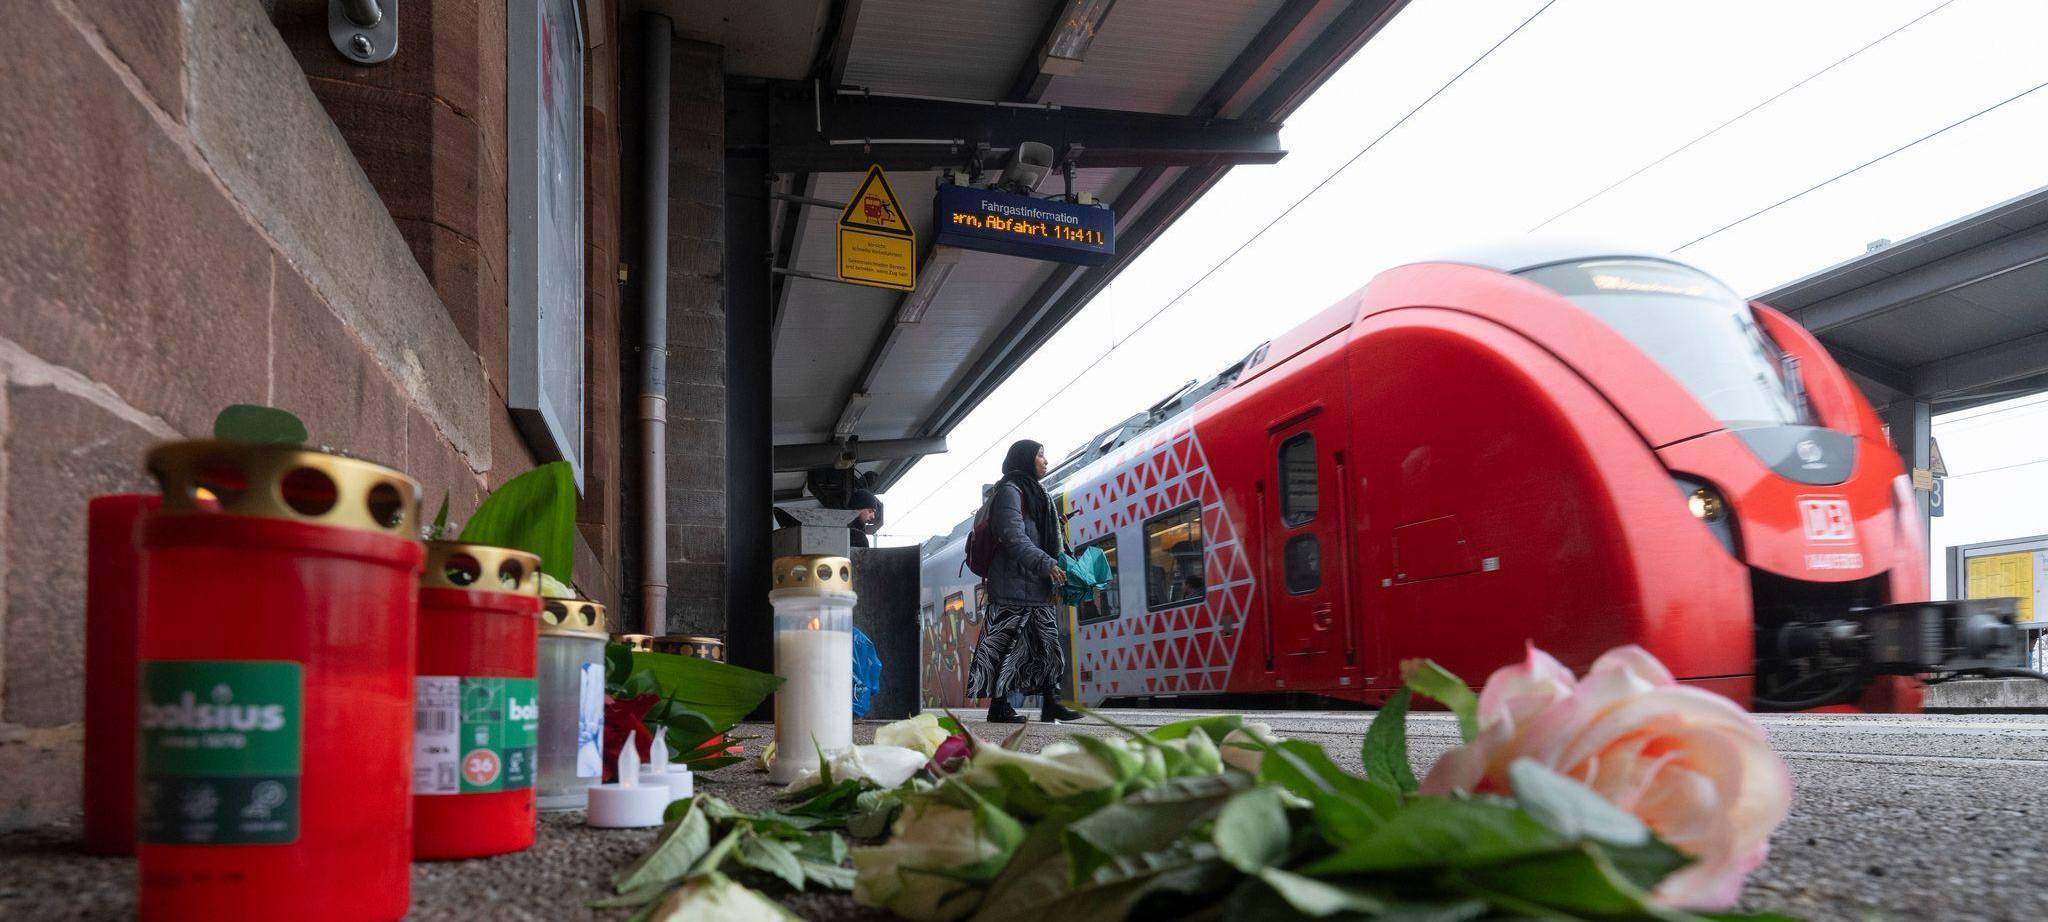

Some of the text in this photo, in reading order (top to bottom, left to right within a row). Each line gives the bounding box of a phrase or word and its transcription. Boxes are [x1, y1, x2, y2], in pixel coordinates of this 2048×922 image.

[981, 200, 1079, 225] Fahrgastinformation
[986, 215, 1048, 237] Abfahrt
[1054, 225, 1093, 244] 11:41
[1931, 480, 1941, 507] 3
[1799, 499, 1856, 540] DB
[469, 758, 494, 774] 36
